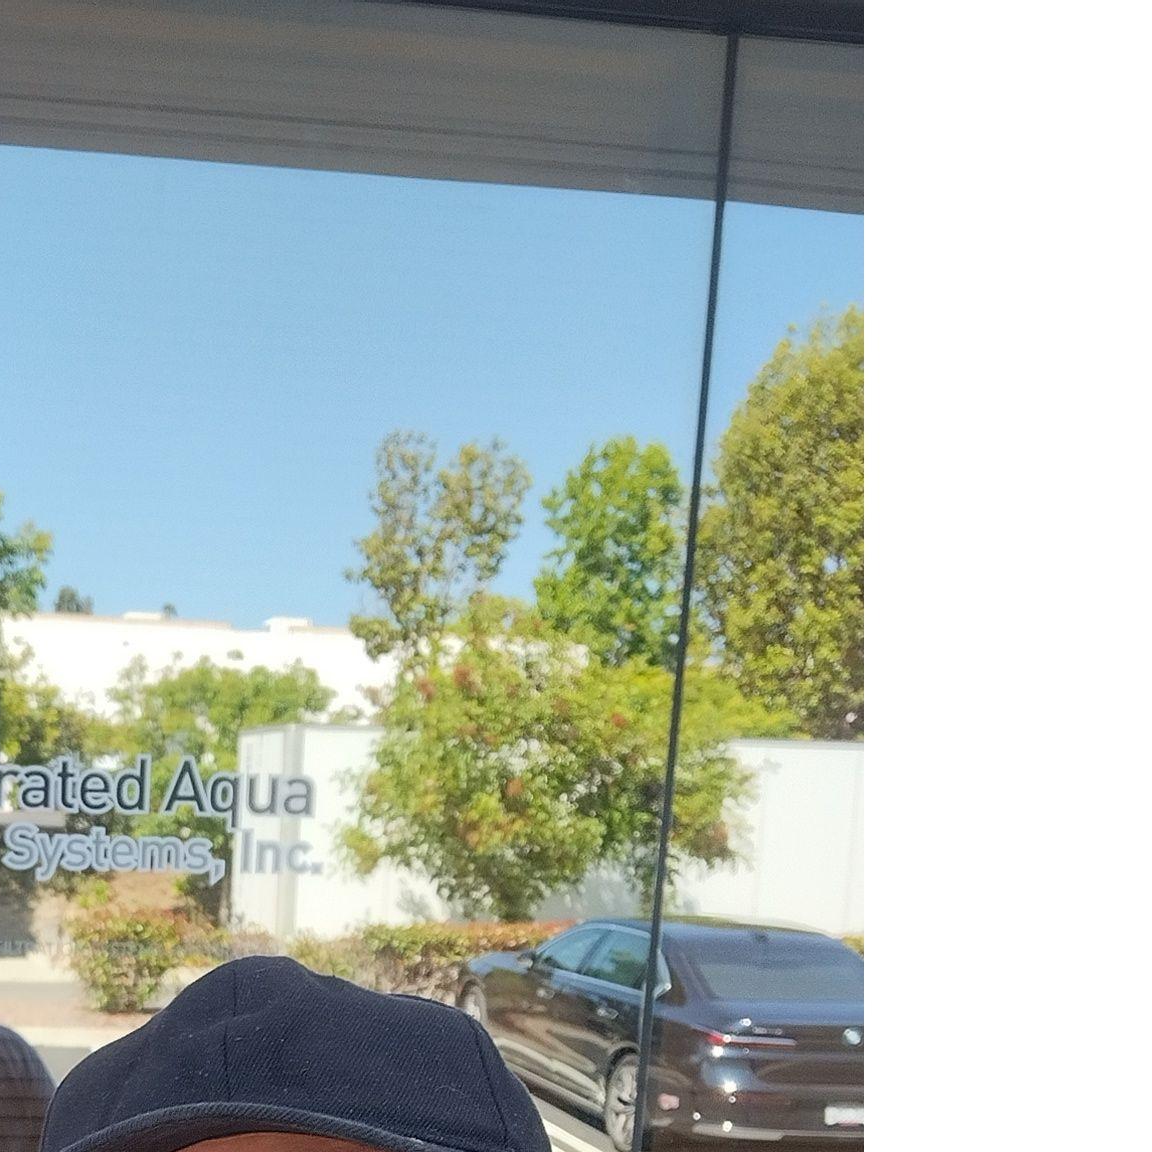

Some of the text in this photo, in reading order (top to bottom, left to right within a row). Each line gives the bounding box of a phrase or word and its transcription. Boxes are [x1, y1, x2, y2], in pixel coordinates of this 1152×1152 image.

[163, 758, 313, 828] Aqua
[4, 823, 323, 883] Systems, Inc.
